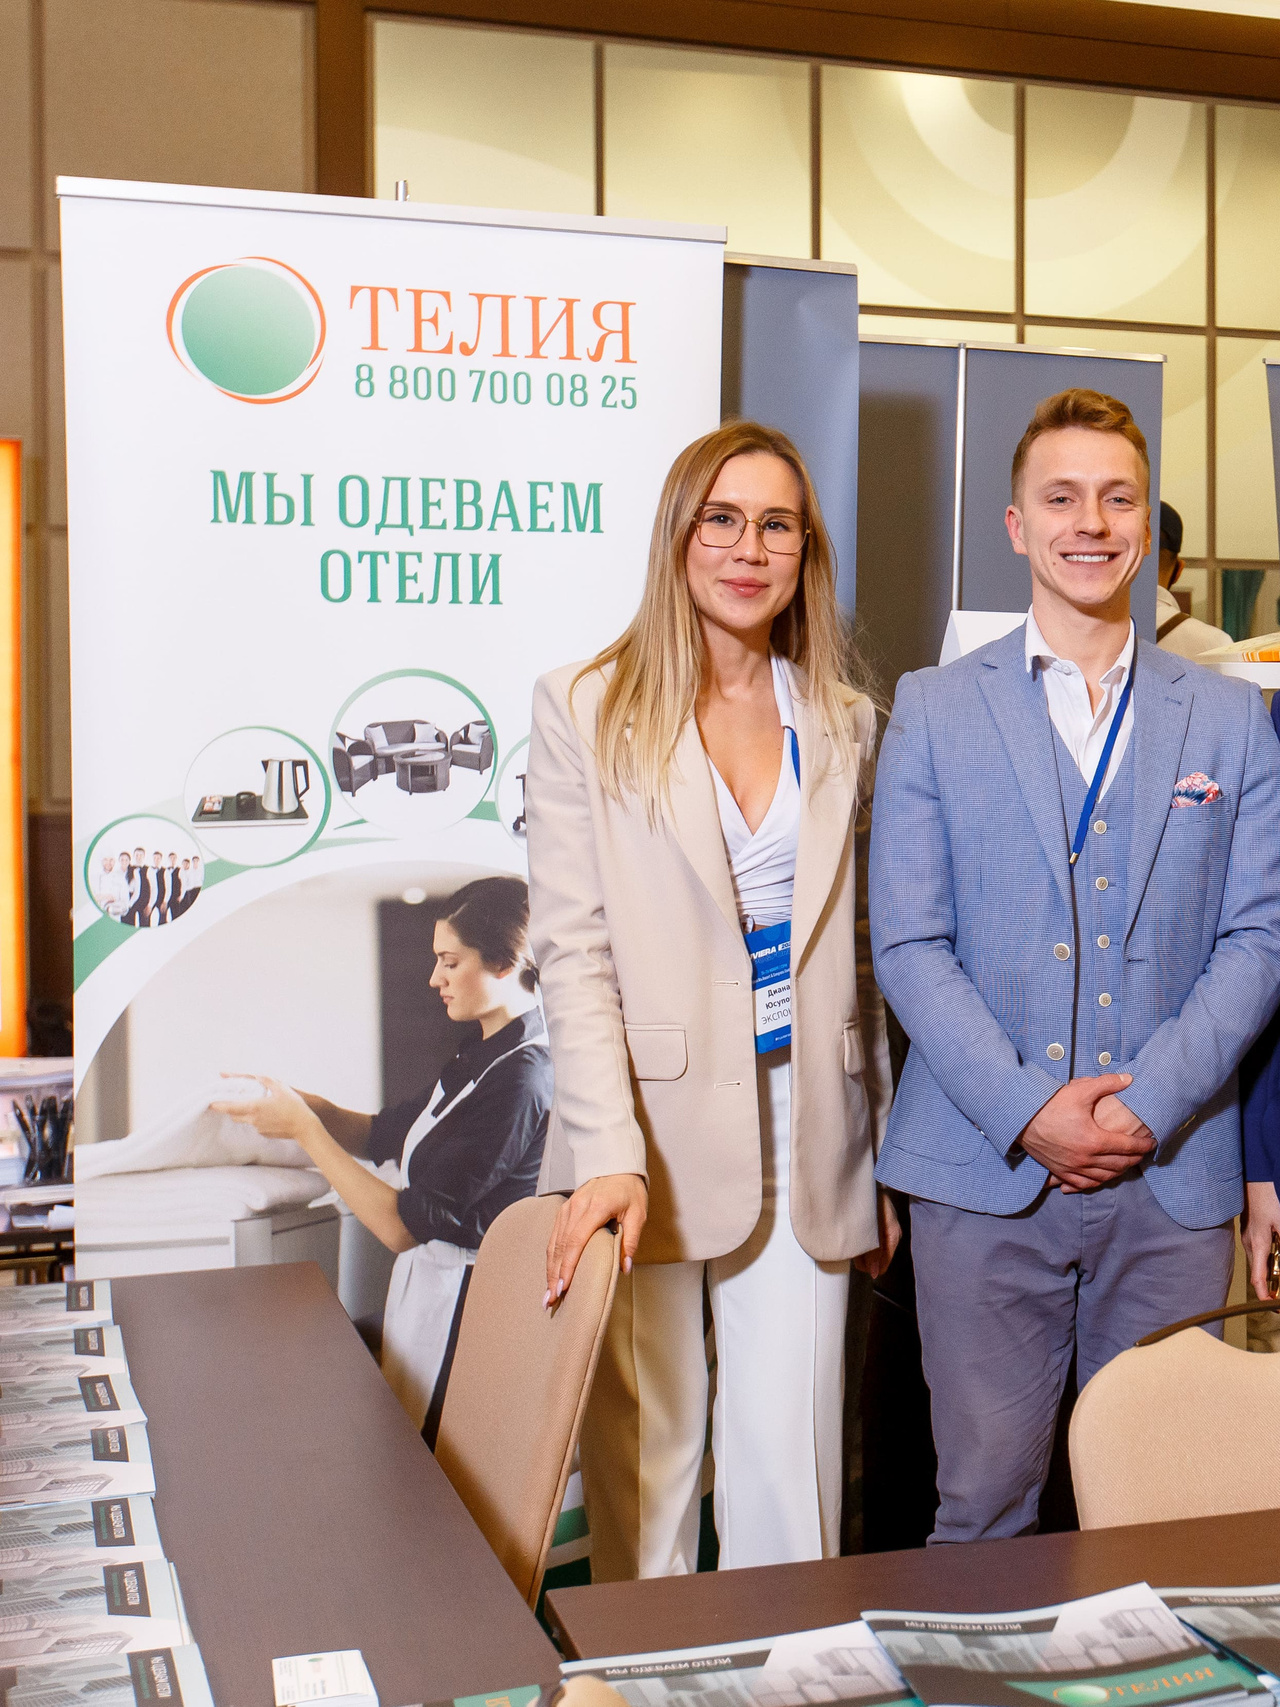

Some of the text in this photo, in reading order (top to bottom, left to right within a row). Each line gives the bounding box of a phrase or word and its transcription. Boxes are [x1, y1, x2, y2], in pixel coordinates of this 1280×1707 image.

[349, 285, 638, 363] ТЕЛИЯ
[354, 363, 638, 409] 8 800 700 08 25
[210, 470, 604, 536] МЫ ОДЕВАЕМ
[320, 549, 503, 606] ОТЕЛИ
[751, 946, 776, 960] VIERA
[767, 985, 791, 998] Диана
[765, 997, 791, 1010] Юсупо
[761, 1010, 791, 1025] ЭКСПО
[605, 1657, 732, 1676] МЫ ОДЕВАЕМ ОТЕЛИ
